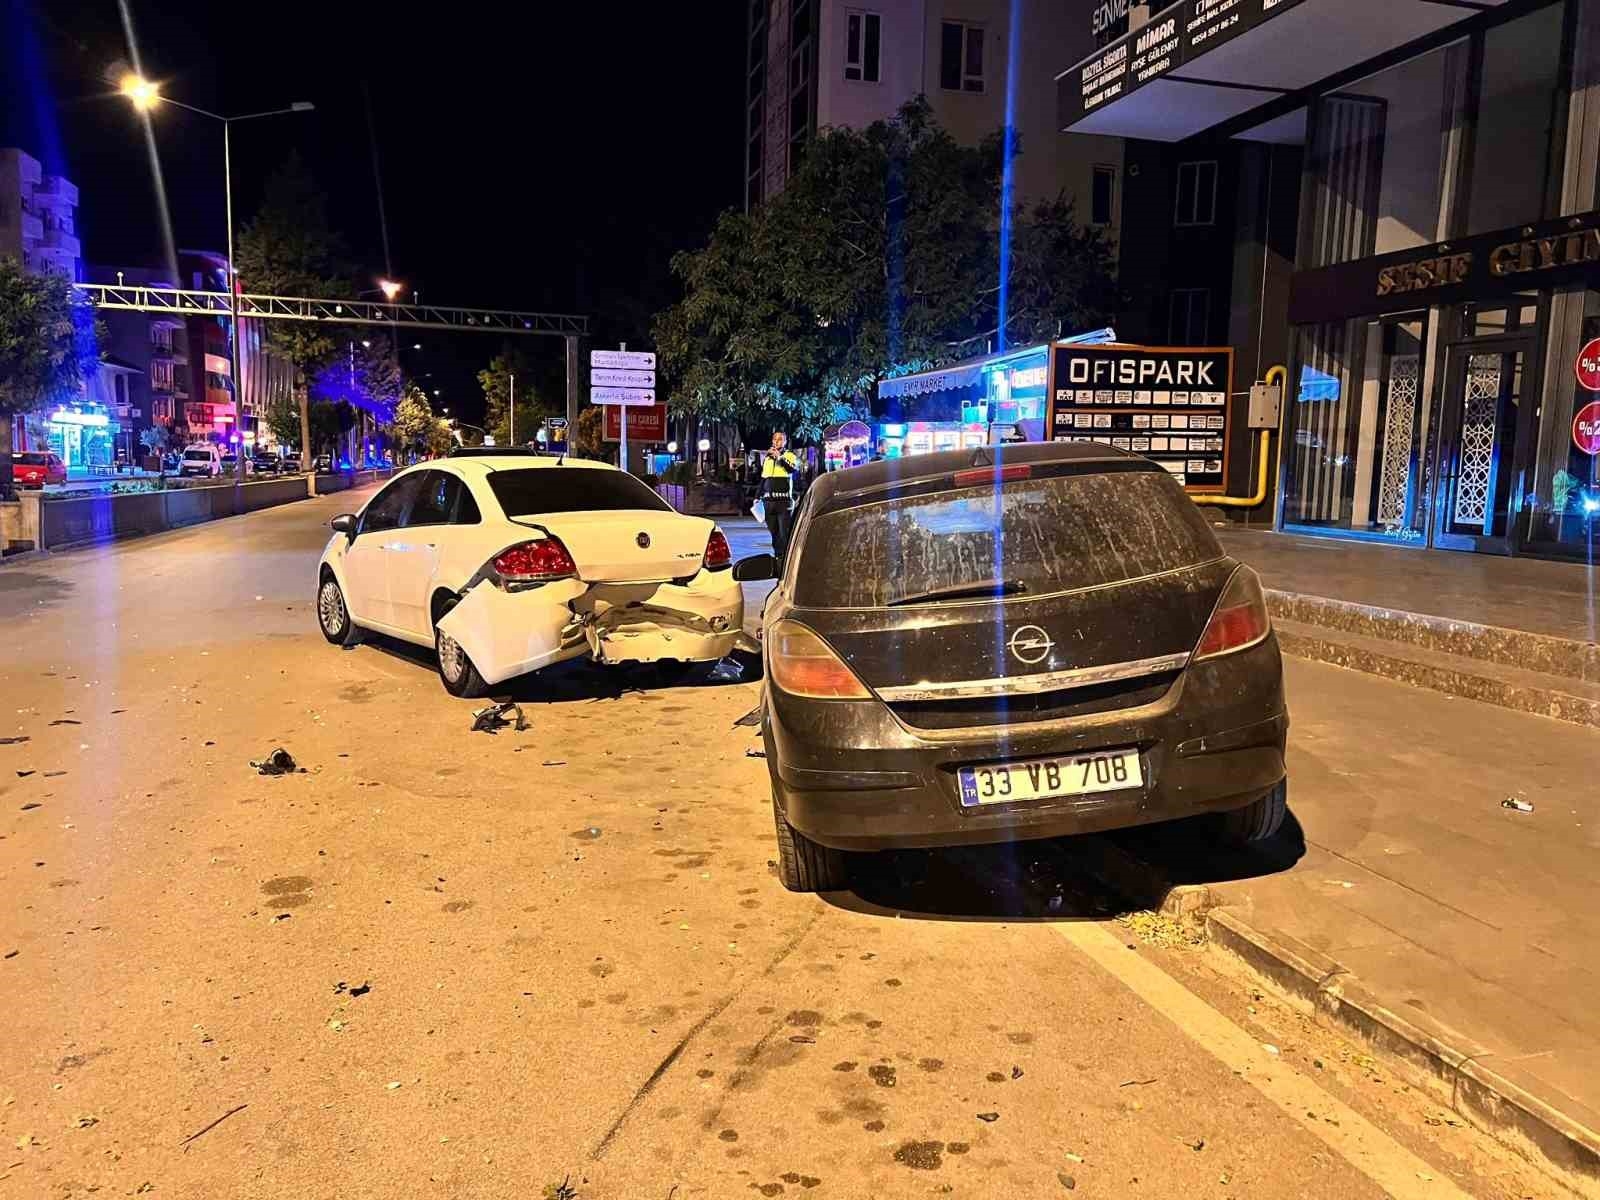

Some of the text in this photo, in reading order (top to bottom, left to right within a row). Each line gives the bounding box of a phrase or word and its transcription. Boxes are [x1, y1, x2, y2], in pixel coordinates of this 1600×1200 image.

[1136, 18, 1176, 55] MİMAR
[965, 788, 977, 798] TR
[978, 755, 1128, 797] 33 VB 708
